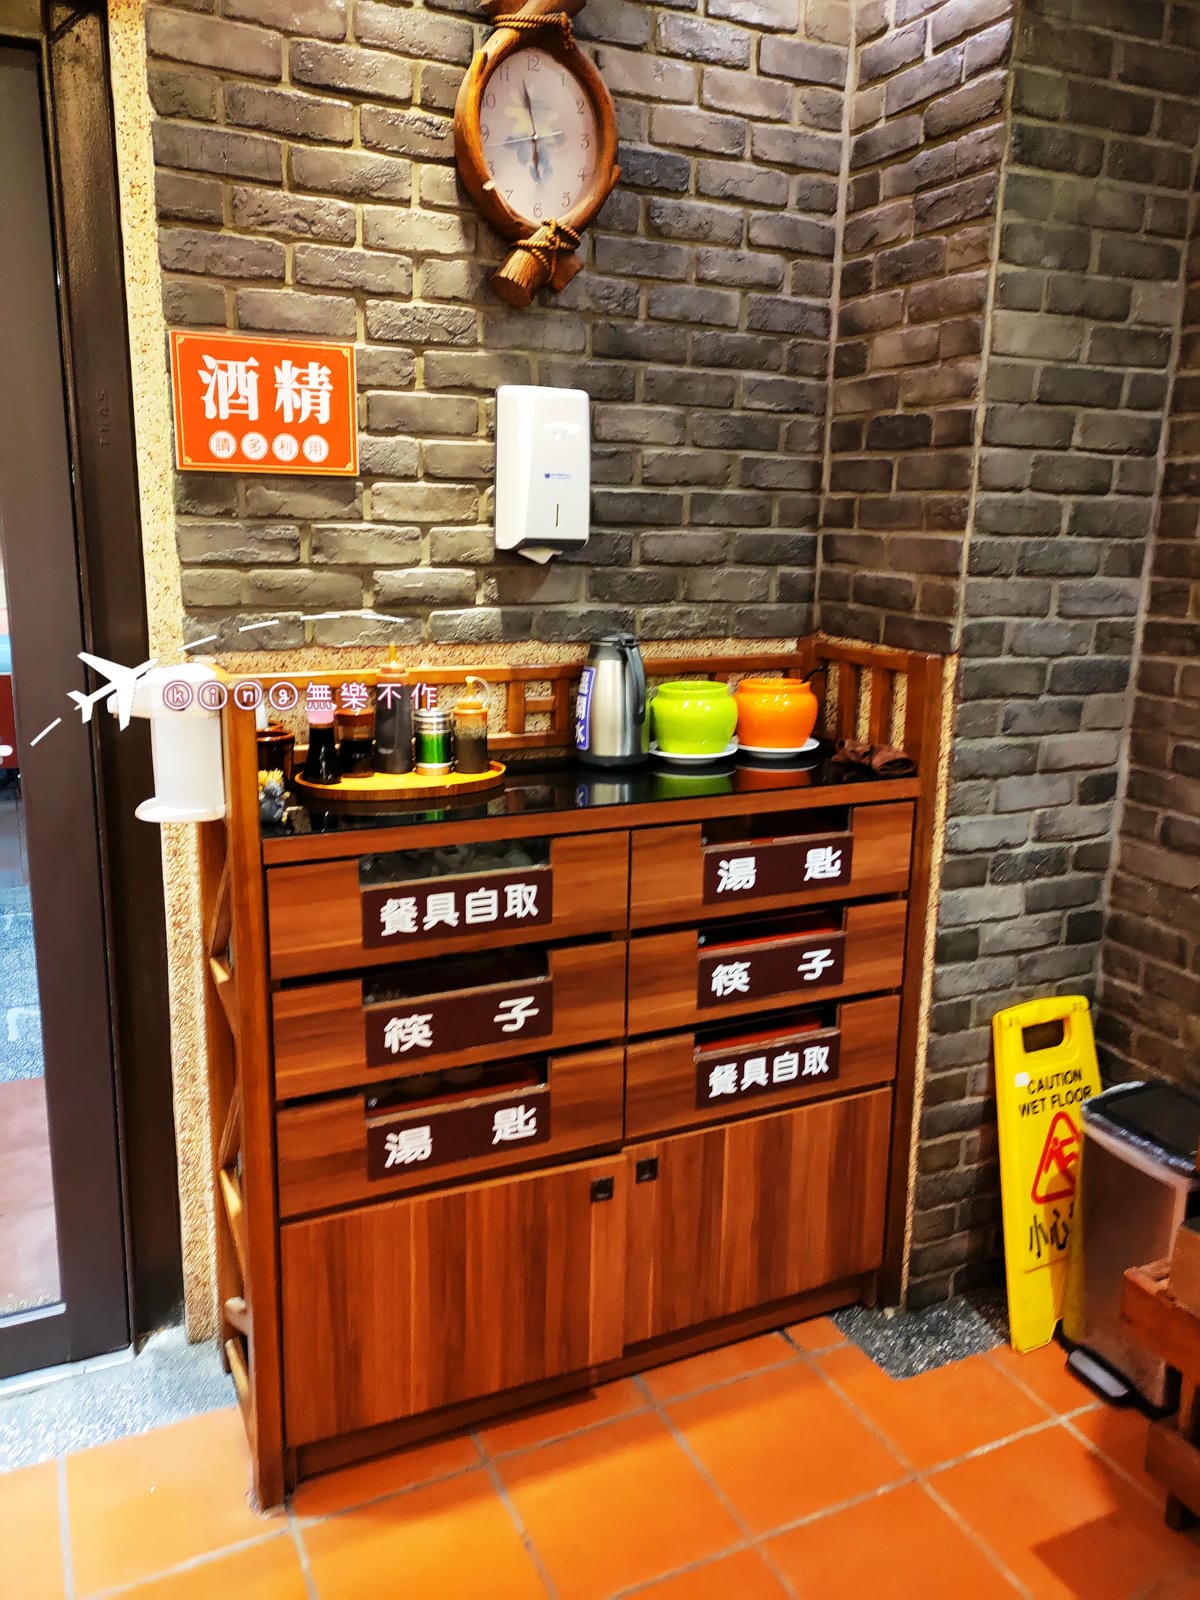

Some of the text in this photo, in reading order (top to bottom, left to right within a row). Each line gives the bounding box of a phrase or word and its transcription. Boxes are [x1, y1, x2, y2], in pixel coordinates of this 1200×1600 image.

[526, 55, 540, 71] 12
[499, 66, 510, 82] 11
[559, 73, 566, 87] 1
[482, 93, 496, 108] 10
[576, 100, 585, 115] 2
[480, 126, 490, 142] 9
[580, 134, 590, 149] 3
[577, 167, 587, 182] 4
[505, 190, 514, 202] 7
[561, 192, 571, 207] 5
[533, 203, 543, 218] 6
[197, 354, 334, 425] 酒精
[212, 433, 326, 460] 請多利用
[716, 846, 843, 894] 湯匙
[379, 883, 540, 936] 餐具自取
[710, 949, 835, 997] 筷子
[383, 995, 540, 1054] 筷子
[708, 1045, 830, 1098] 餐具自取
[1027, 1068, 1083, 1095] CAUTION
[1018, 1085, 1092, 1117] WET FLOOR
[384, 1104, 538, 1168] 湯匙
[1029, 1202, 1075, 1259] 小心
